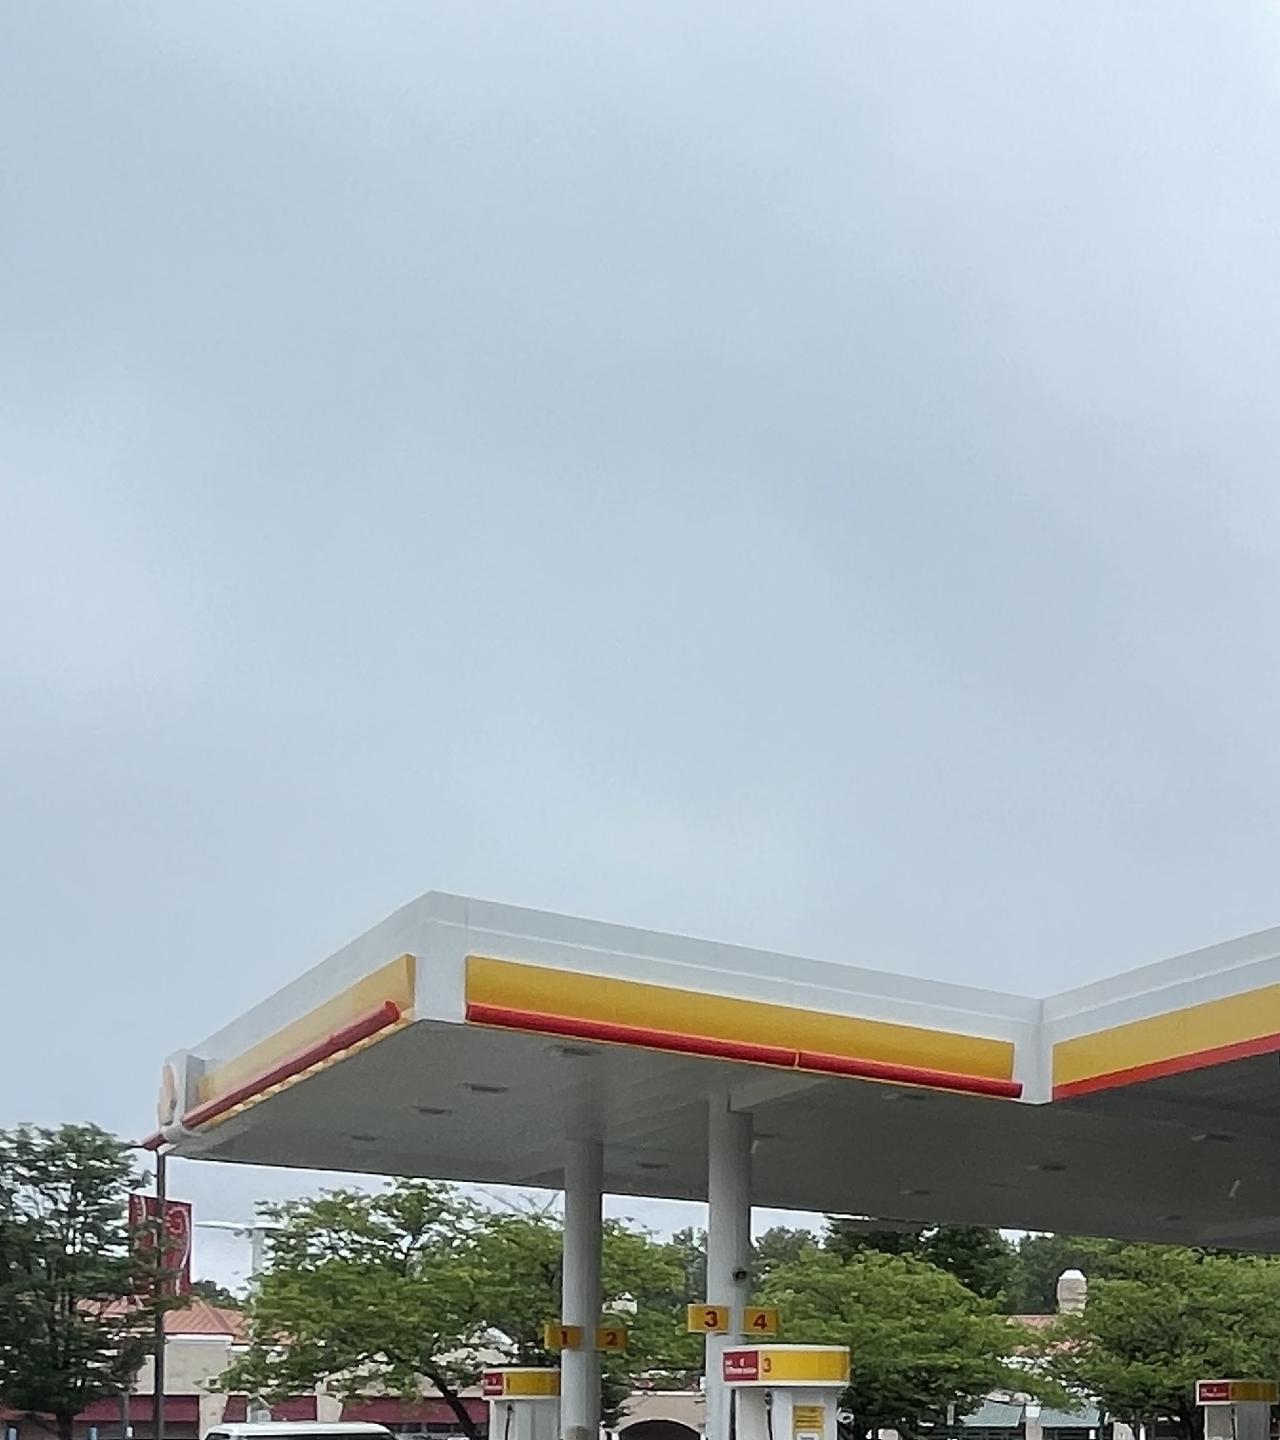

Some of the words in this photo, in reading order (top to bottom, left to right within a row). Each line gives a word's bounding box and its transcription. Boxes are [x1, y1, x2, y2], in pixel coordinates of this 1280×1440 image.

[703, 1310, 718, 1328] 3
[752, 1313, 769, 1331] 4
[559, 1330, 569, 1345] 1
[605, 1331, 619, 1346] 2
[762, 1357, 772, 1374] 3
